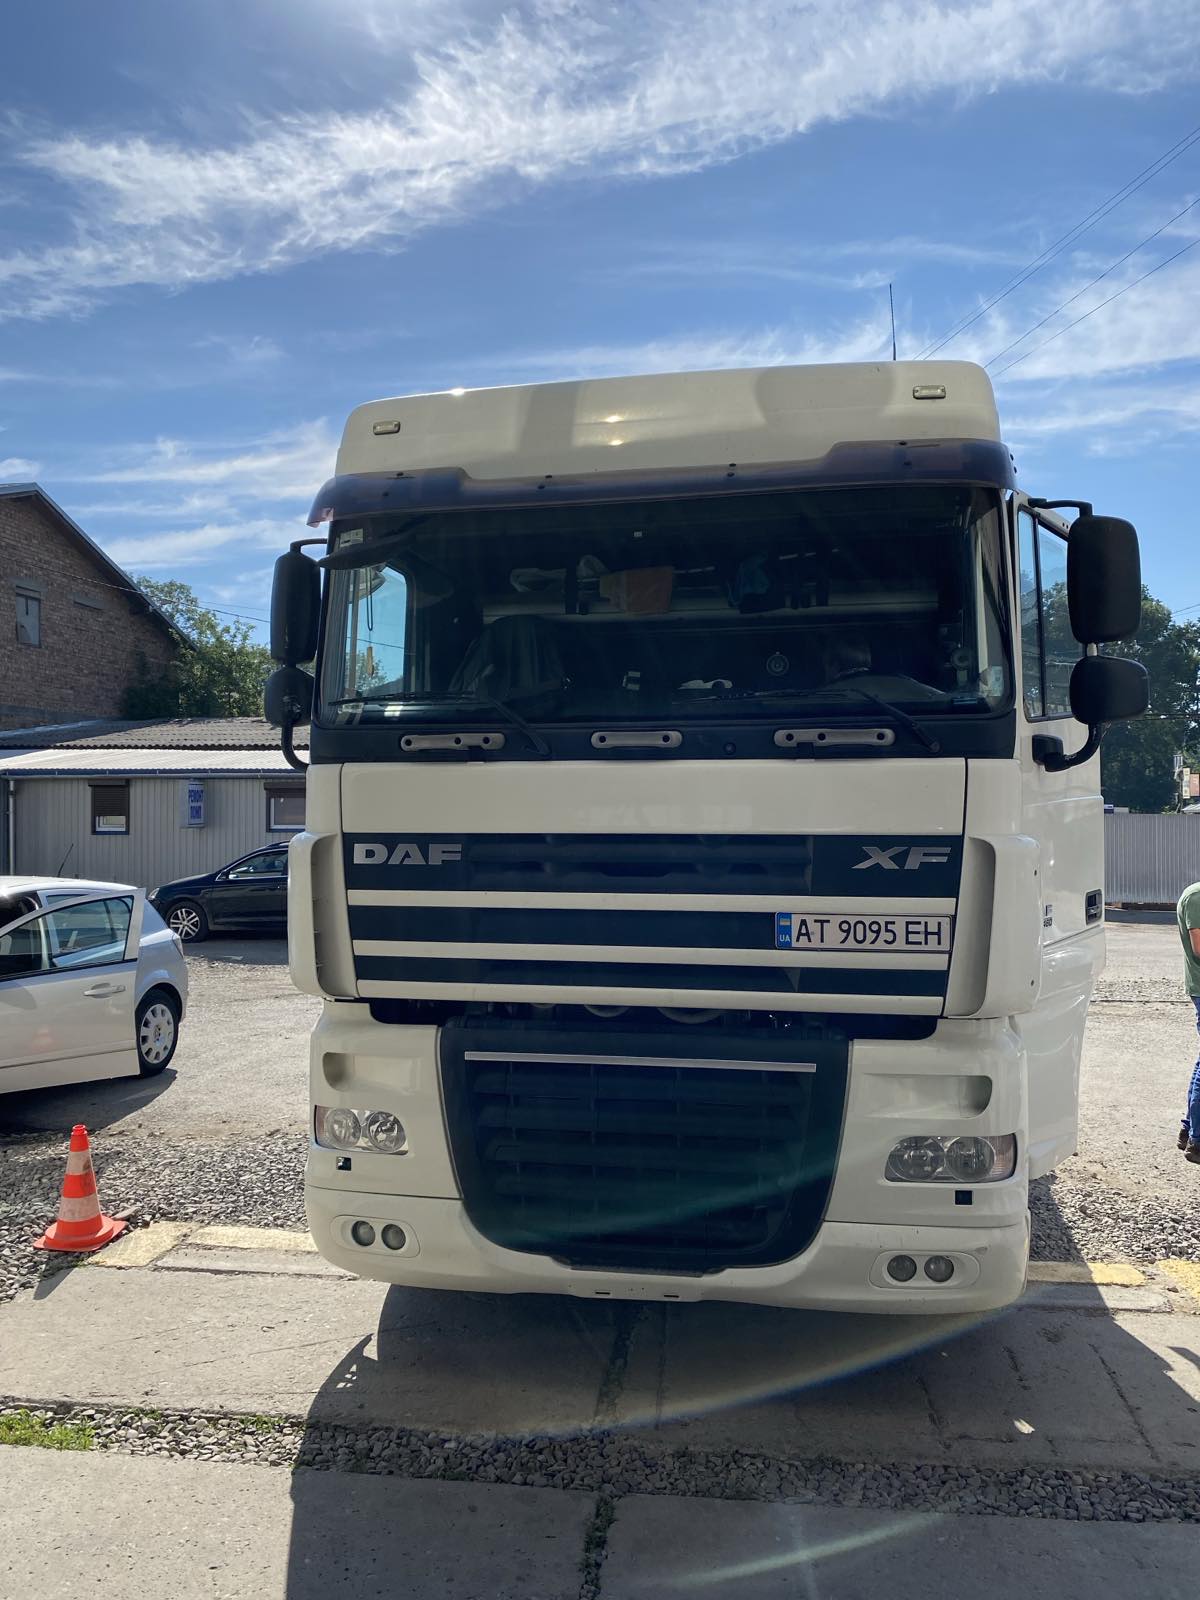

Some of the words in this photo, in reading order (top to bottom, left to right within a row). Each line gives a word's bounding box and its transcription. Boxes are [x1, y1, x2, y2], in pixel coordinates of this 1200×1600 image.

[353, 843, 462, 865] DAF
[851, 846, 952, 870] XF
[779, 934, 791, 942] UA
[795, 918, 831, 943] AT
[838, 920, 897, 945] 9095
[905, 921, 942, 946] EH
